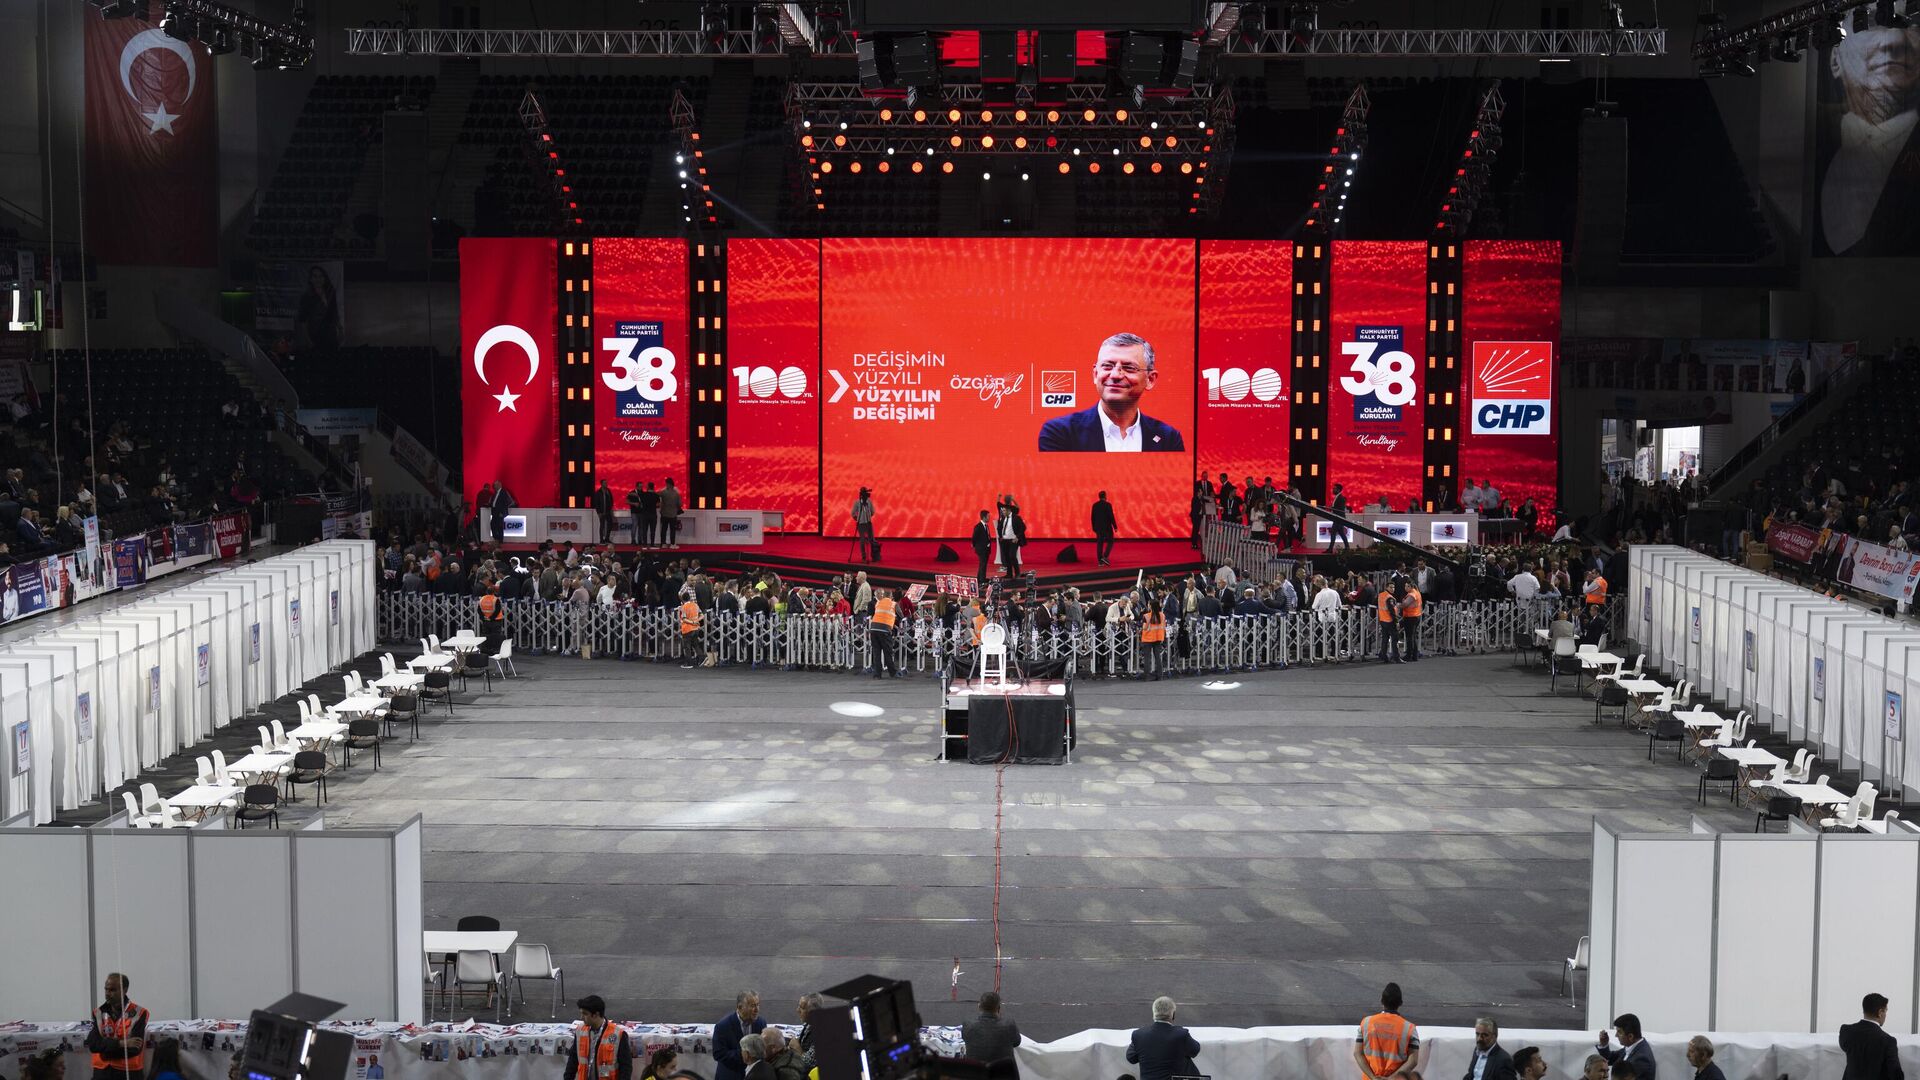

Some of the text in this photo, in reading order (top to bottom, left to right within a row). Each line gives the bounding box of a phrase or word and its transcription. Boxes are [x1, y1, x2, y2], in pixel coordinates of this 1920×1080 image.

[853, 351, 945, 370] DEĞİŞİMİN
[732, 365, 807, 399] 100
[853, 368, 921, 385] YÜZYILI
[950, 374, 1006, 390] ÖZGÜR
[1201, 367, 1282, 402] 100
[853, 386, 941, 403] YÜZYILIN
[979, 373, 1025, 409] Özel
[1045, 394, 1073, 405] CHP
[853, 404, 935, 423] DEĞİŞİMİ
[1478, 404, 1545, 429] CHP
[505, 522, 523, 530] CHP
[731, 523, 748, 532] CHP
[1389, 528, 1406, 536] CHP
[1694, 613, 1699, 627] 2
[199, 652, 208, 668] 20
[80, 702, 89, 720] 18
[1889, 700, 1895, 717] 5
[20, 730, 27, 750] 17
